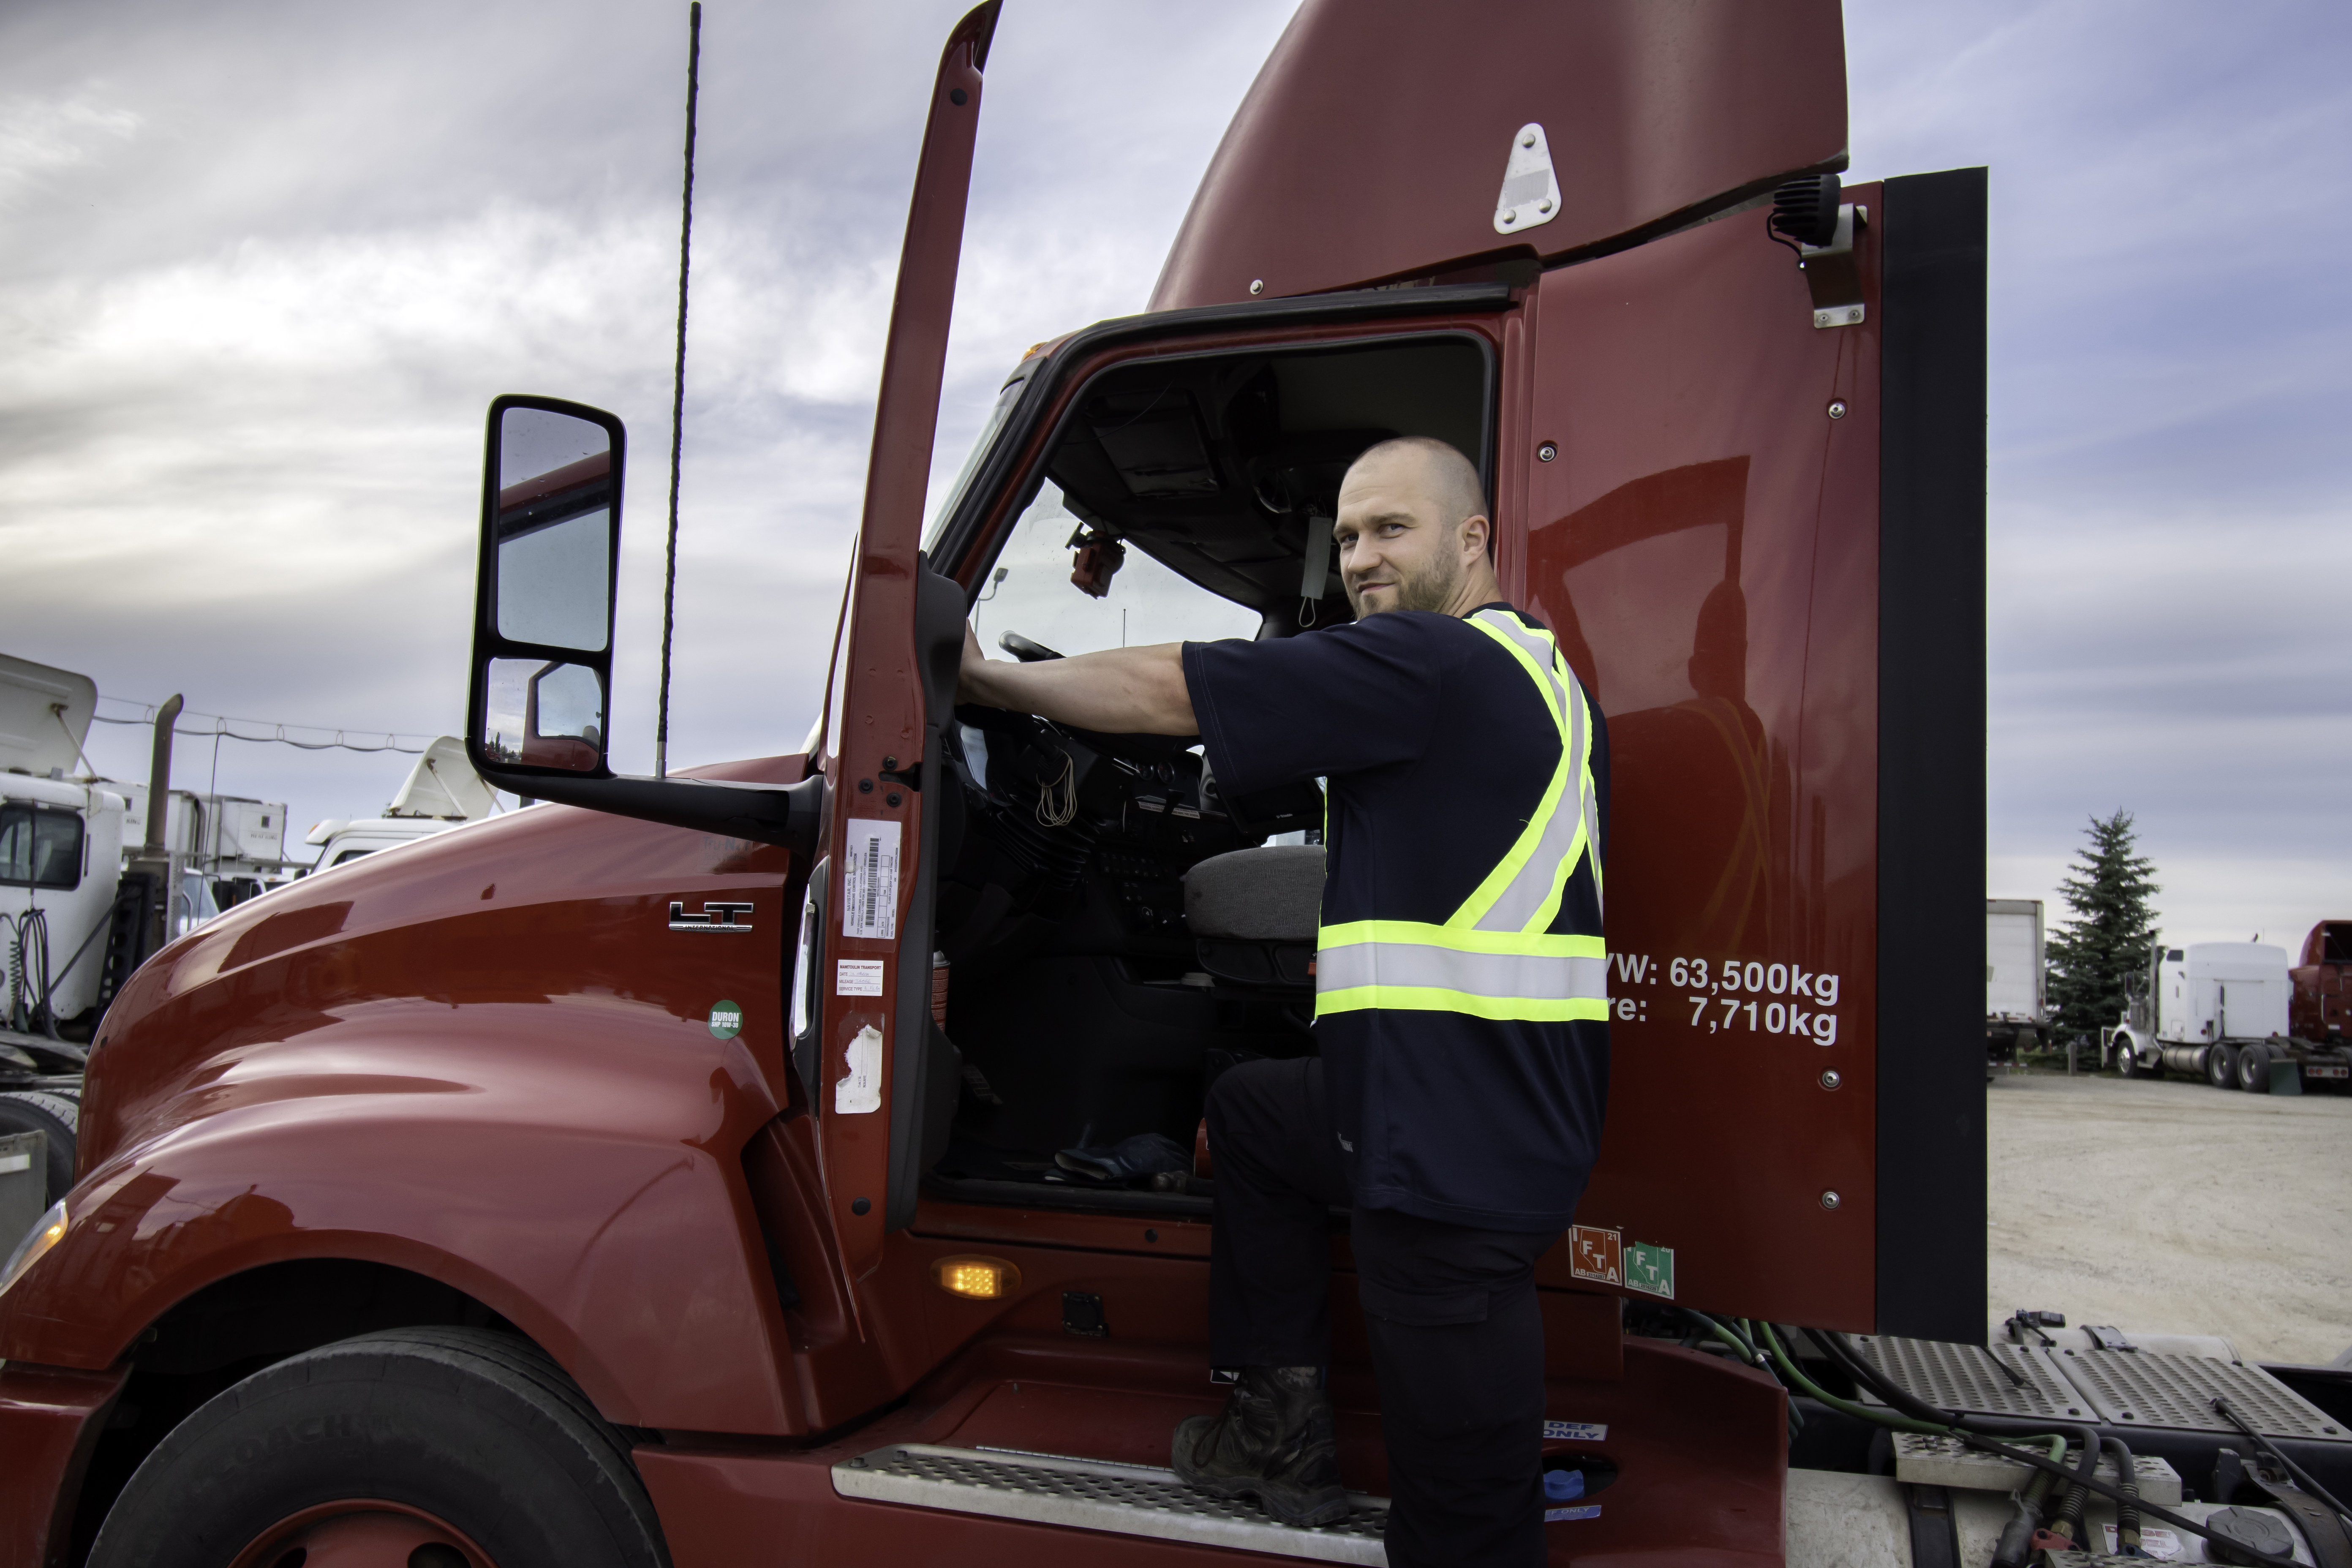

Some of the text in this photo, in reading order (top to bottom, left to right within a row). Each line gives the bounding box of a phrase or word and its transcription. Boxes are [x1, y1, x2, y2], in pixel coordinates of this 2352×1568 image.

[669, 902, 754, 925] LT
[1670, 957, 1839, 1006] 63,500kg
[712, 1012, 739, 1022] DURON
[1689, 996, 1837, 1046] 7,710kg
[1608, 1233, 1617, 1241] 21
[1549, 1422, 1594, 1430] DEF
[1544, 1429, 1600, 1439] ONLY
